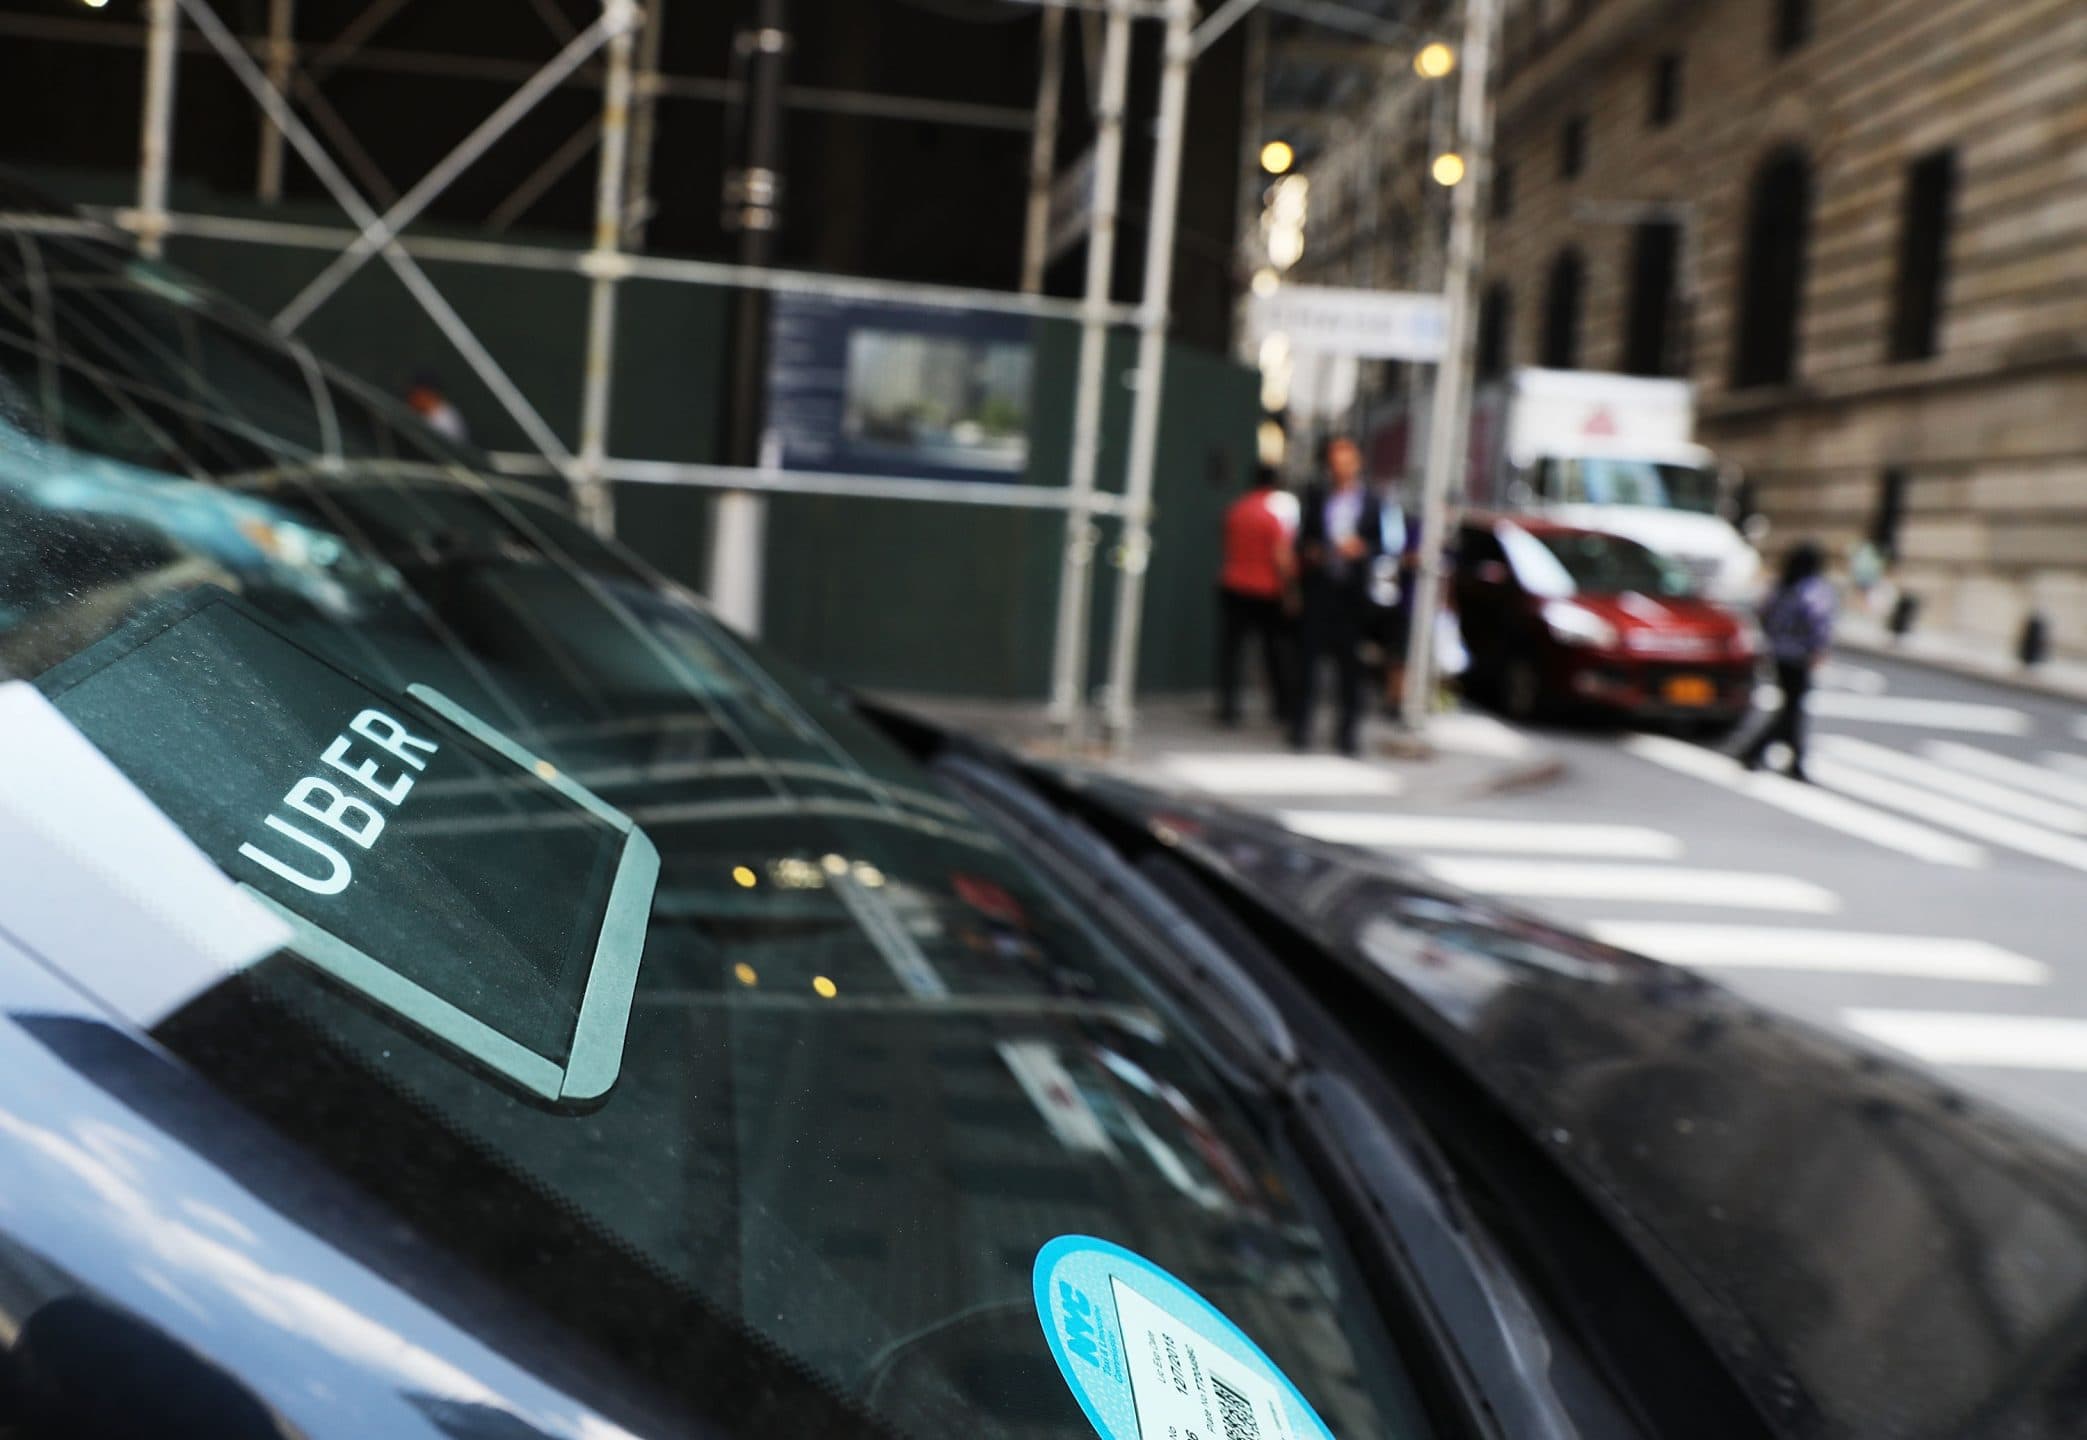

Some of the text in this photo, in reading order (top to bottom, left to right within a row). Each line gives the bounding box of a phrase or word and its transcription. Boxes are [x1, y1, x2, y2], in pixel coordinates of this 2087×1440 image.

[238, 709, 439, 894] UBER
[1059, 1280, 1099, 1367] NYC
[1161, 1333, 1188, 1395] 12/7/2018
